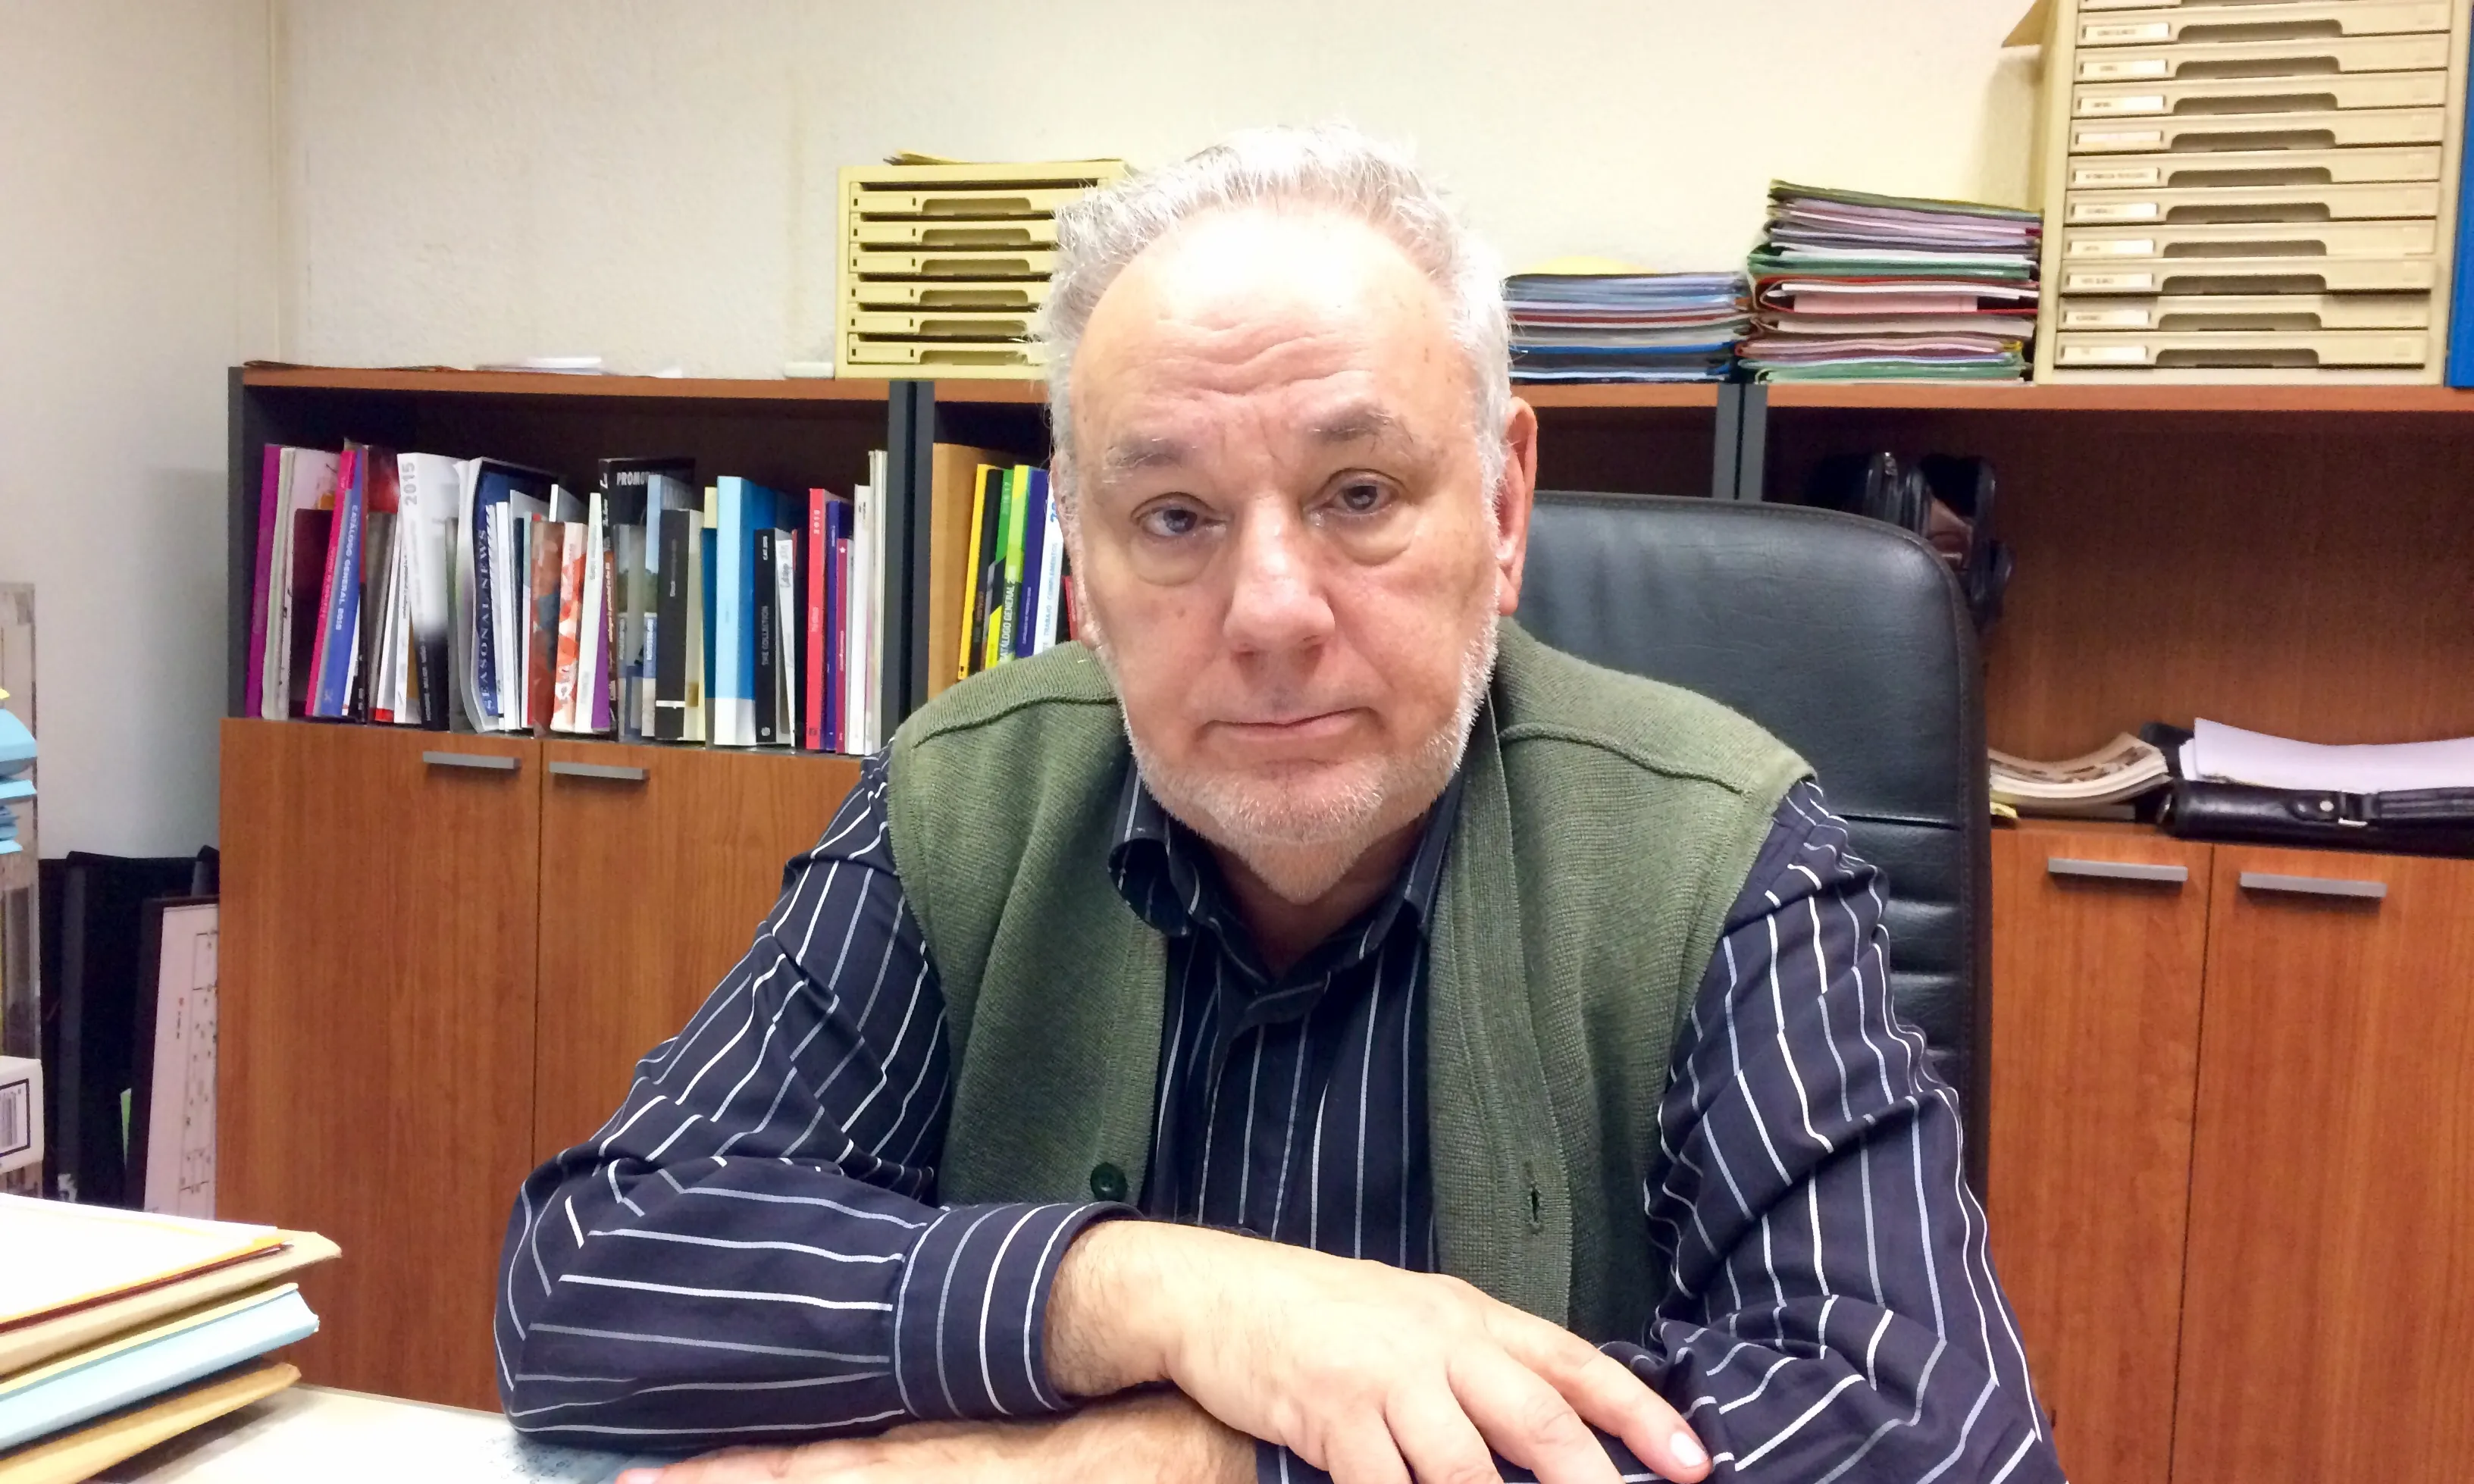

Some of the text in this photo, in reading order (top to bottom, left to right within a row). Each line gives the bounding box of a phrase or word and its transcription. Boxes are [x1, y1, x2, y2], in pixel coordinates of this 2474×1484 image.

[402, 462, 417, 506] 2015
[338, 559, 351, 605] GENERAL
[1003, 585, 1015, 621] GENERAL
[478, 529, 494, 711] SEASONAL NEWS
[760, 606, 769, 665] THE COLLECTION
